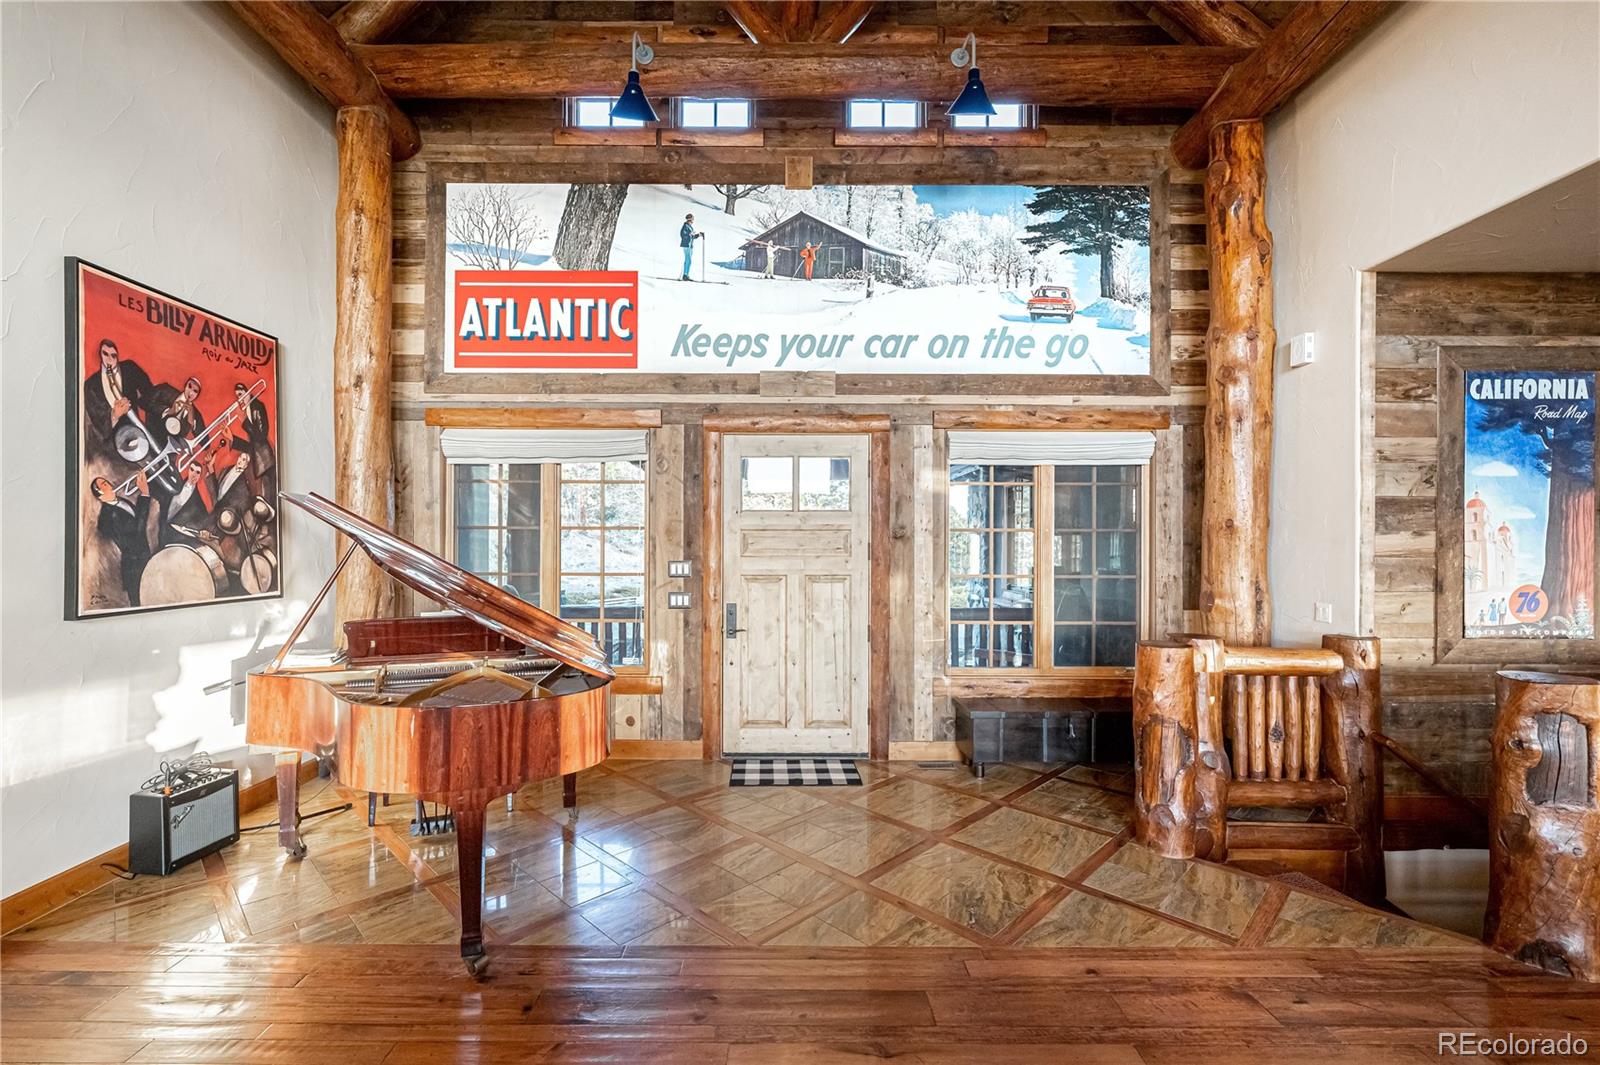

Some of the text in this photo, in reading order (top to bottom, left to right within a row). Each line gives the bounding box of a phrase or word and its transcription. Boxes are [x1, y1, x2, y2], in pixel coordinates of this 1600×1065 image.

[118, 293, 274, 366] LES BILLY ARNOLDS
[458, 297, 634, 341] ATLANTIC
[670, 323, 1089, 368] Keeps your car on the go
[1469, 378, 1589, 400] CALIFORNIA
[1533, 404, 1588, 424] Road Map
[1516, 590, 1541, 613] 76
